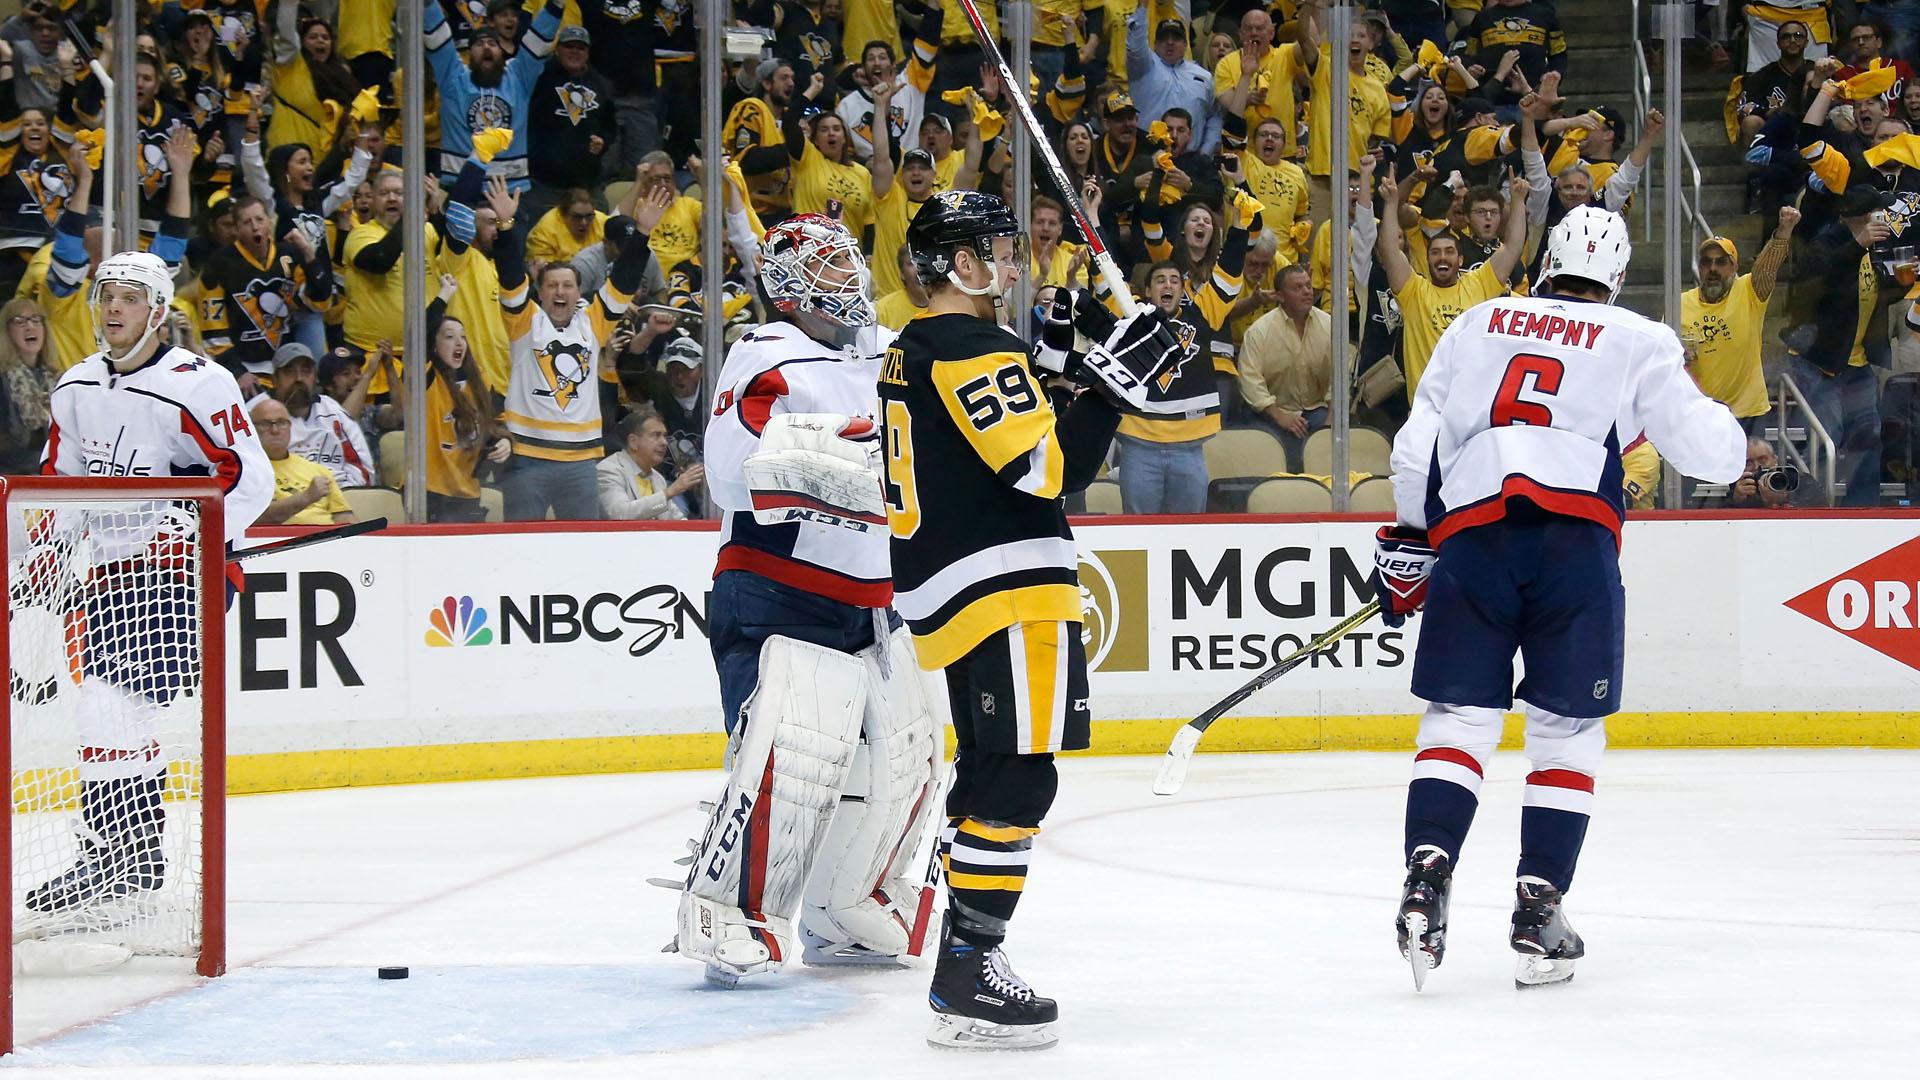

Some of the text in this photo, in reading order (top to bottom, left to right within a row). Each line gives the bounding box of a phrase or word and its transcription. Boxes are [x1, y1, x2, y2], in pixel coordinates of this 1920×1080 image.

[1587, 240, 1597, 254] 6
[1487, 307, 1605, 350] KEMPNY
[954, 363, 1039, 433] 59
[1489, 352, 1565, 428] 6
[210, 403, 252, 447] 74
[783, 509, 869, 534] CCM
[1171, 546, 1379, 620] MGM
[1375, 553, 1425, 572] UER
[500, 584, 711, 657] NBCSN
[1826, 579, 1920, 630] OR
[1171, 632, 1405, 671] RESORTS
[706, 792, 753, 882] CCM
